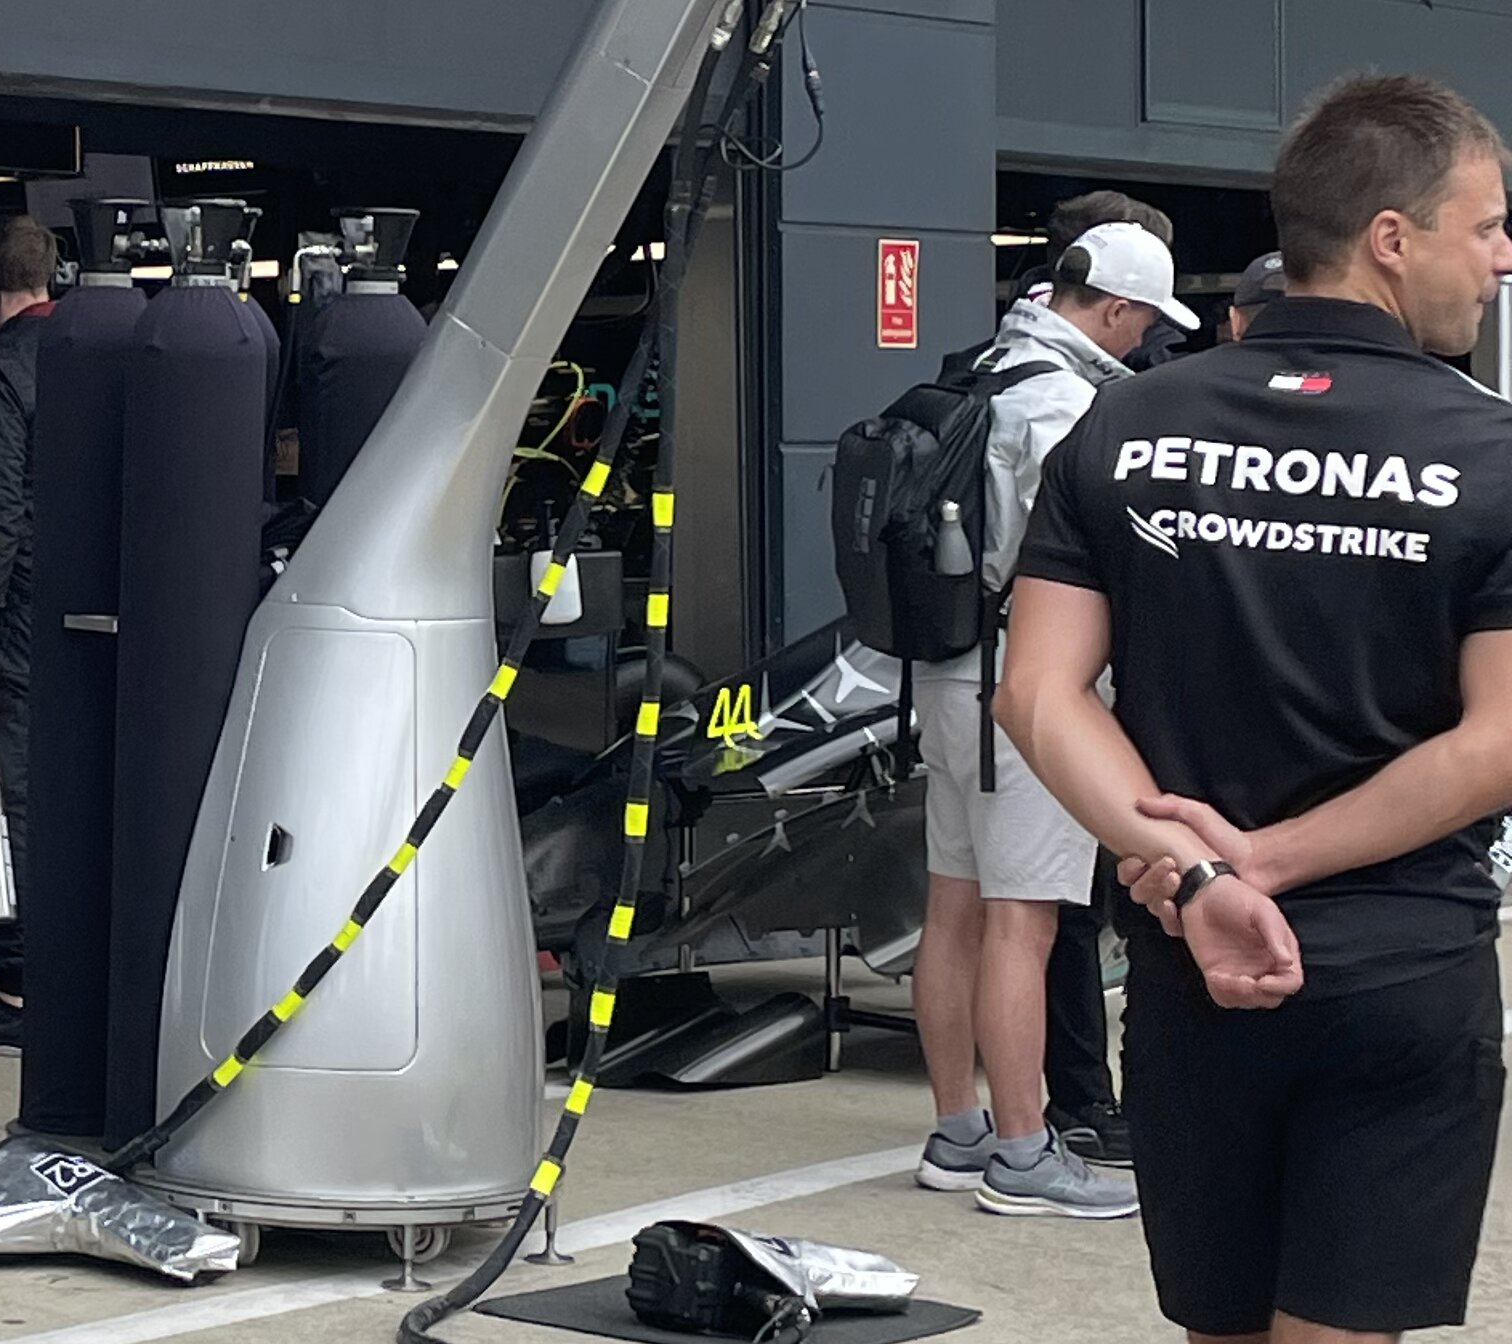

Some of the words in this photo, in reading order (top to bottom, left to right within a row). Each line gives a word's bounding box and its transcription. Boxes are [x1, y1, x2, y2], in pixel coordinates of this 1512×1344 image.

[1113, 436, 1462, 508] PETRONAS
[1148, 508, 1431, 563] CROWDSTRIKE
[707, 684, 764, 748] 44
